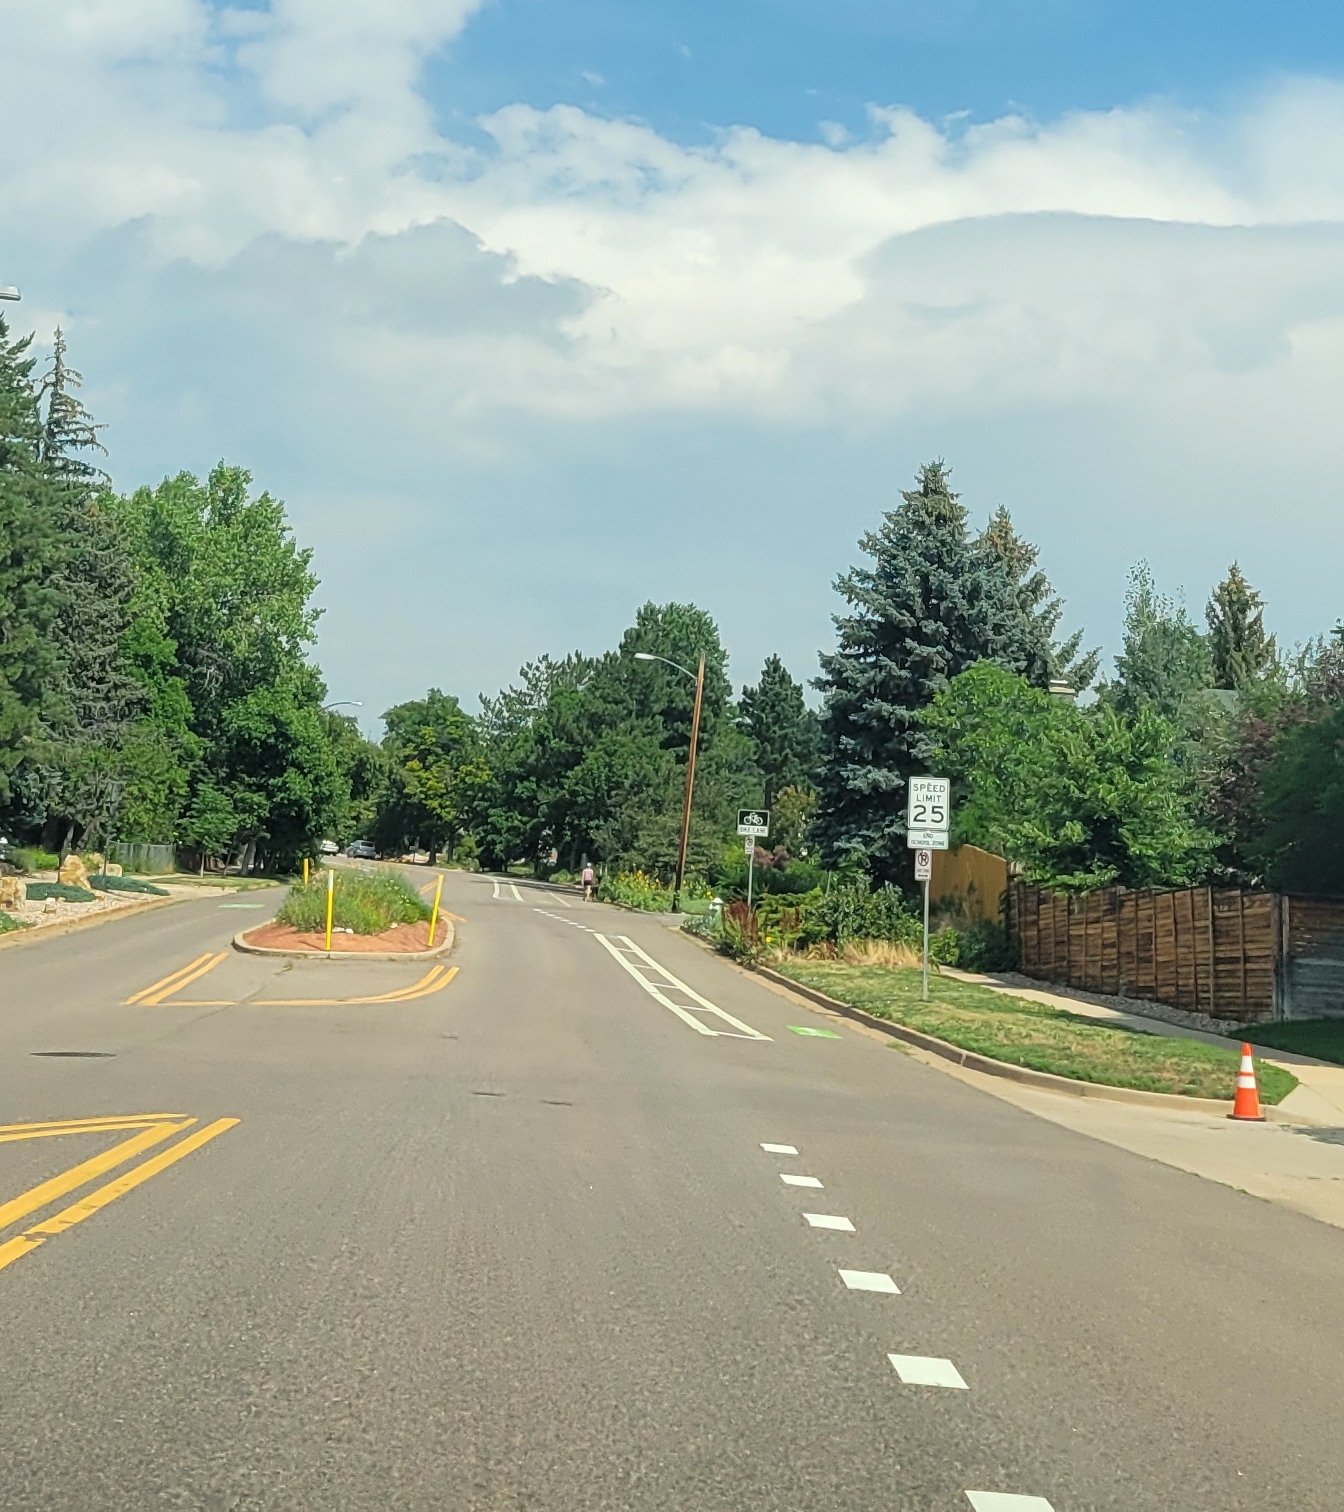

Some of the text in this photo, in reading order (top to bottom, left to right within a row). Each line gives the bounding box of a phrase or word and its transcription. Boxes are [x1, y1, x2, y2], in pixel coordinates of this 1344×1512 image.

[913, 783, 945, 793] SPEED
[916, 794, 941, 803] LIMIT
[913, 804, 944, 823] 25
